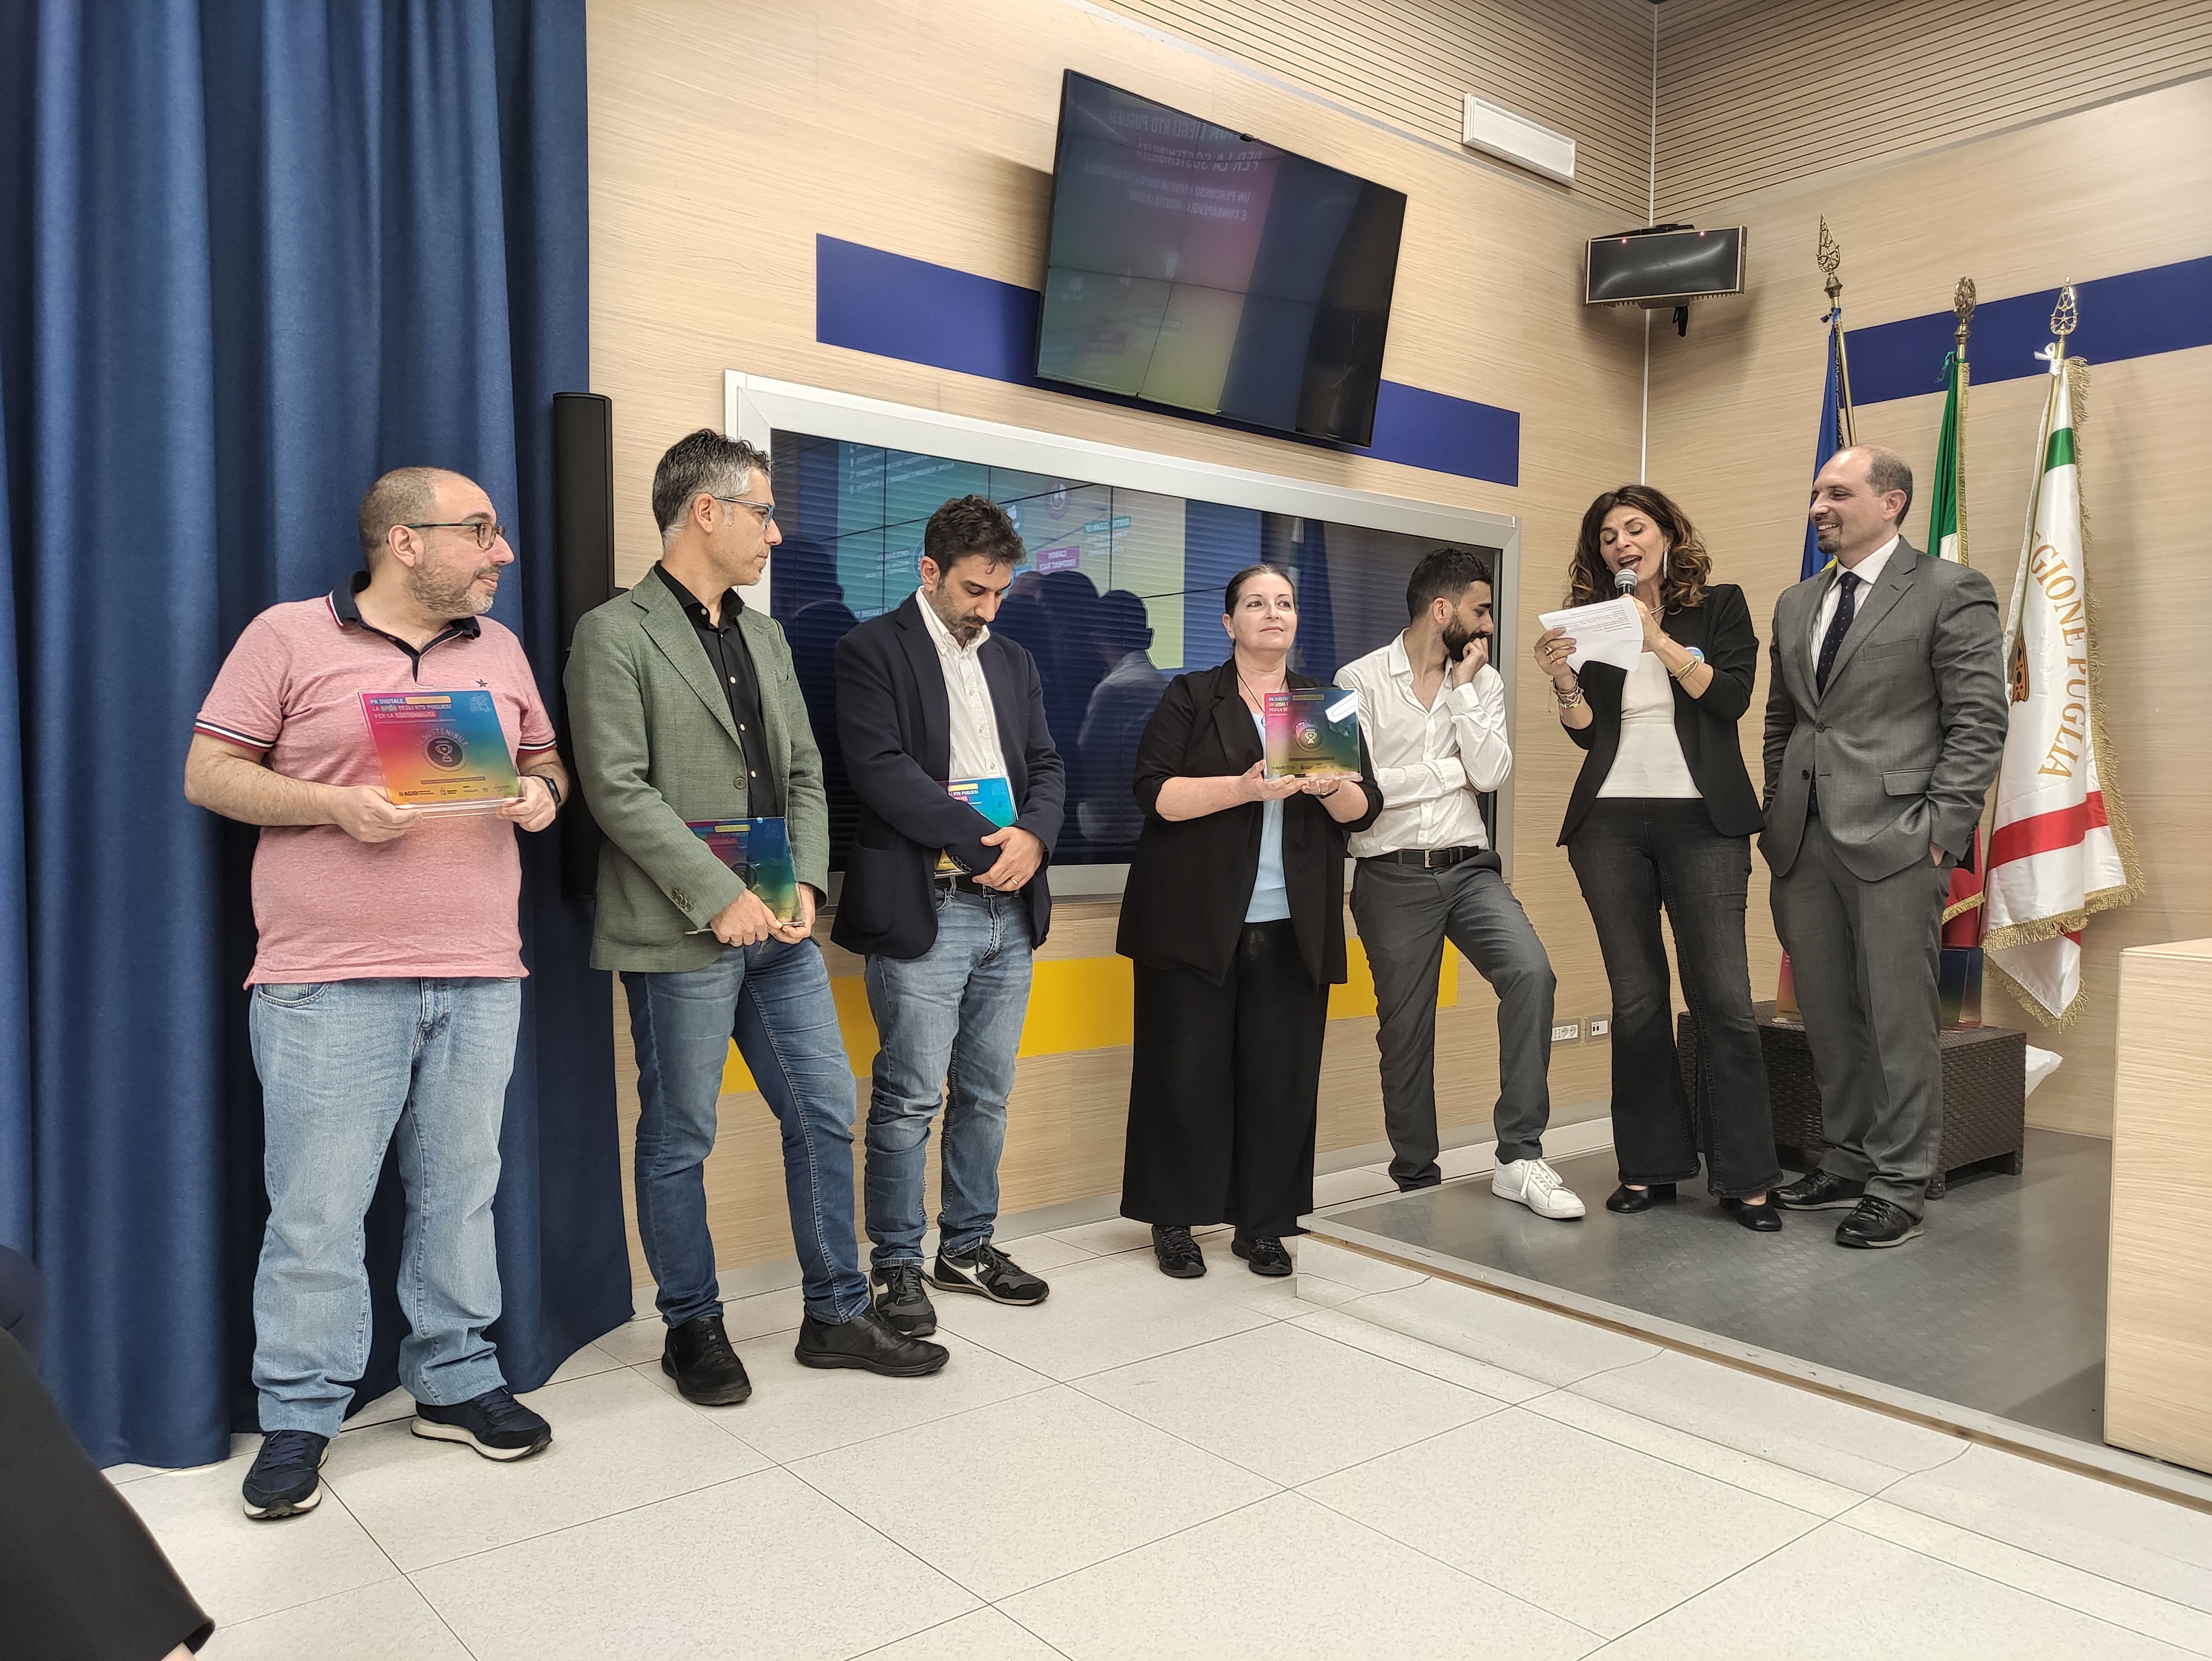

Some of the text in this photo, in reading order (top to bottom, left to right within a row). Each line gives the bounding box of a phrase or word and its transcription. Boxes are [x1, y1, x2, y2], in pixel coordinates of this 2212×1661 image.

[2031, 532, 2086, 777] GIONE PUGLIA
[421, 728, 469, 747] SOSTENIBILE
